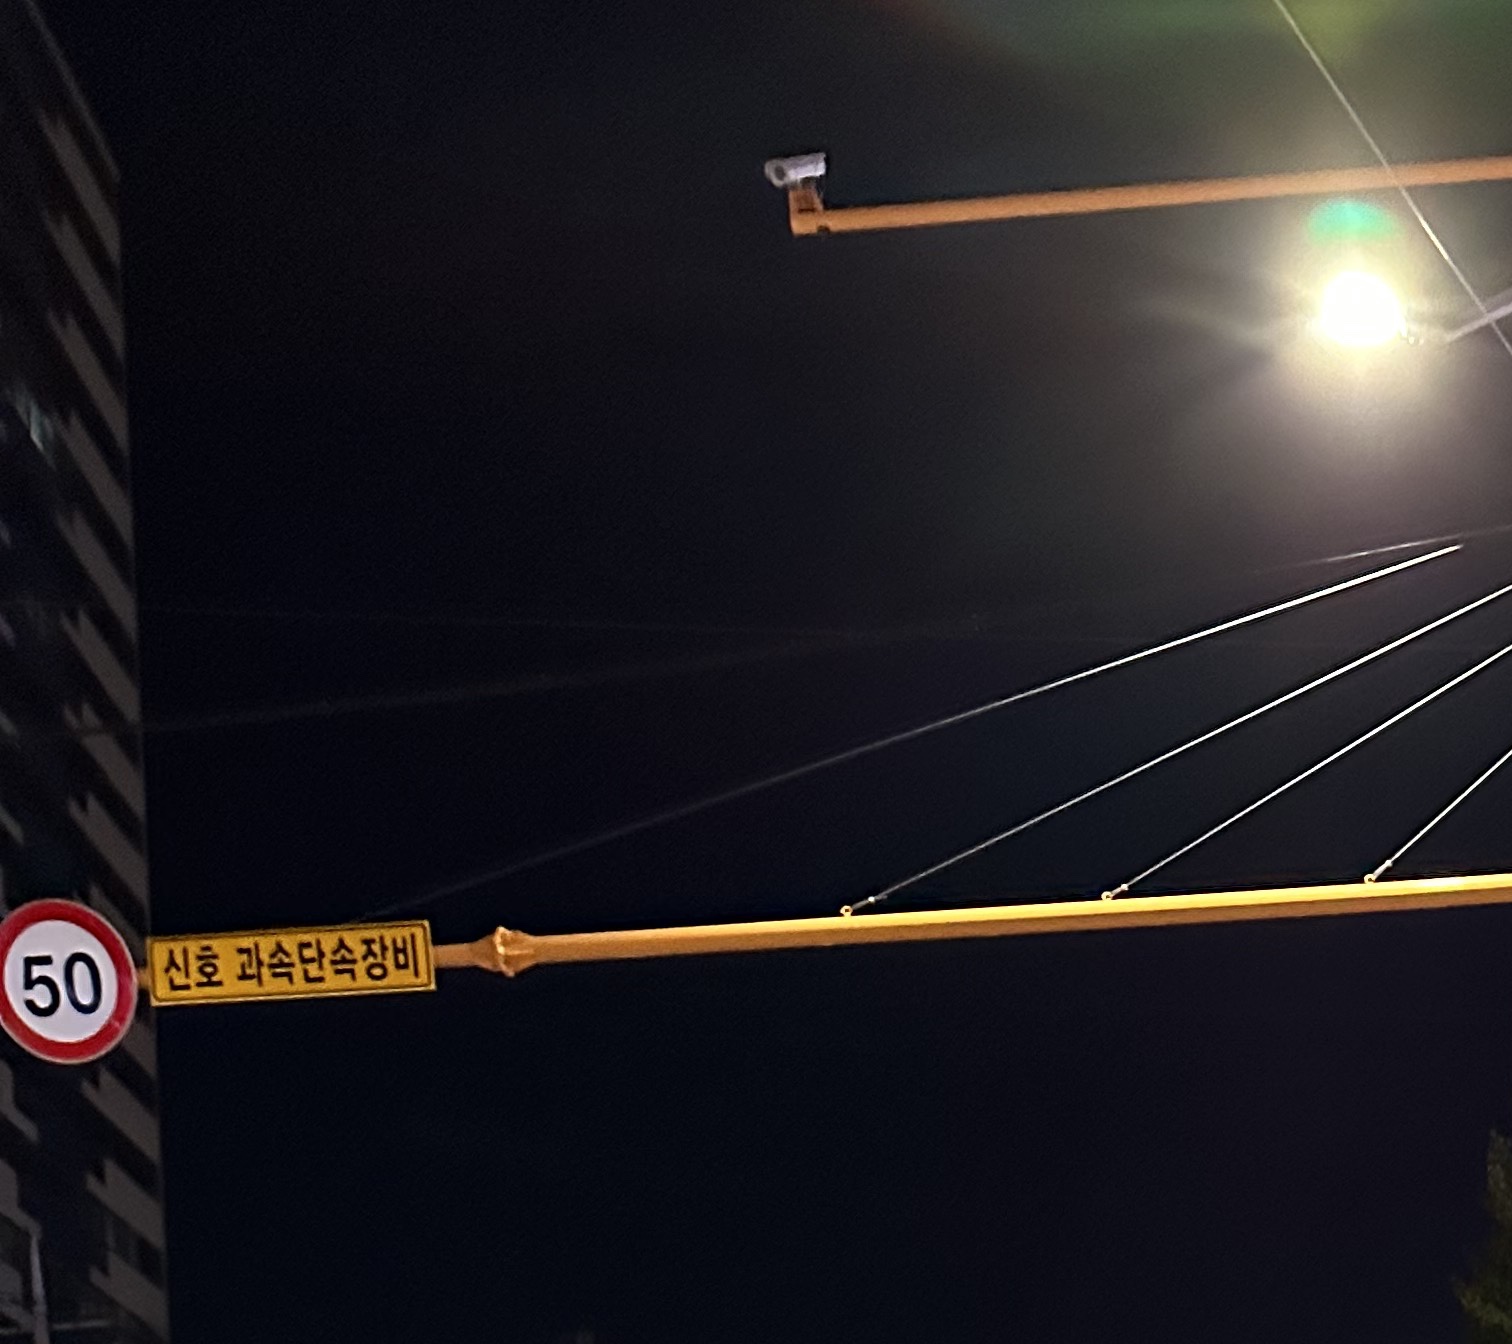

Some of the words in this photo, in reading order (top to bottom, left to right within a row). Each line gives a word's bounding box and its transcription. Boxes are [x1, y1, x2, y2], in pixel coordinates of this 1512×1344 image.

[23, 952, 103, 1018] 50
[162, 943, 225, 994] 신호
[235, 932, 421, 988] 과속단속장비
